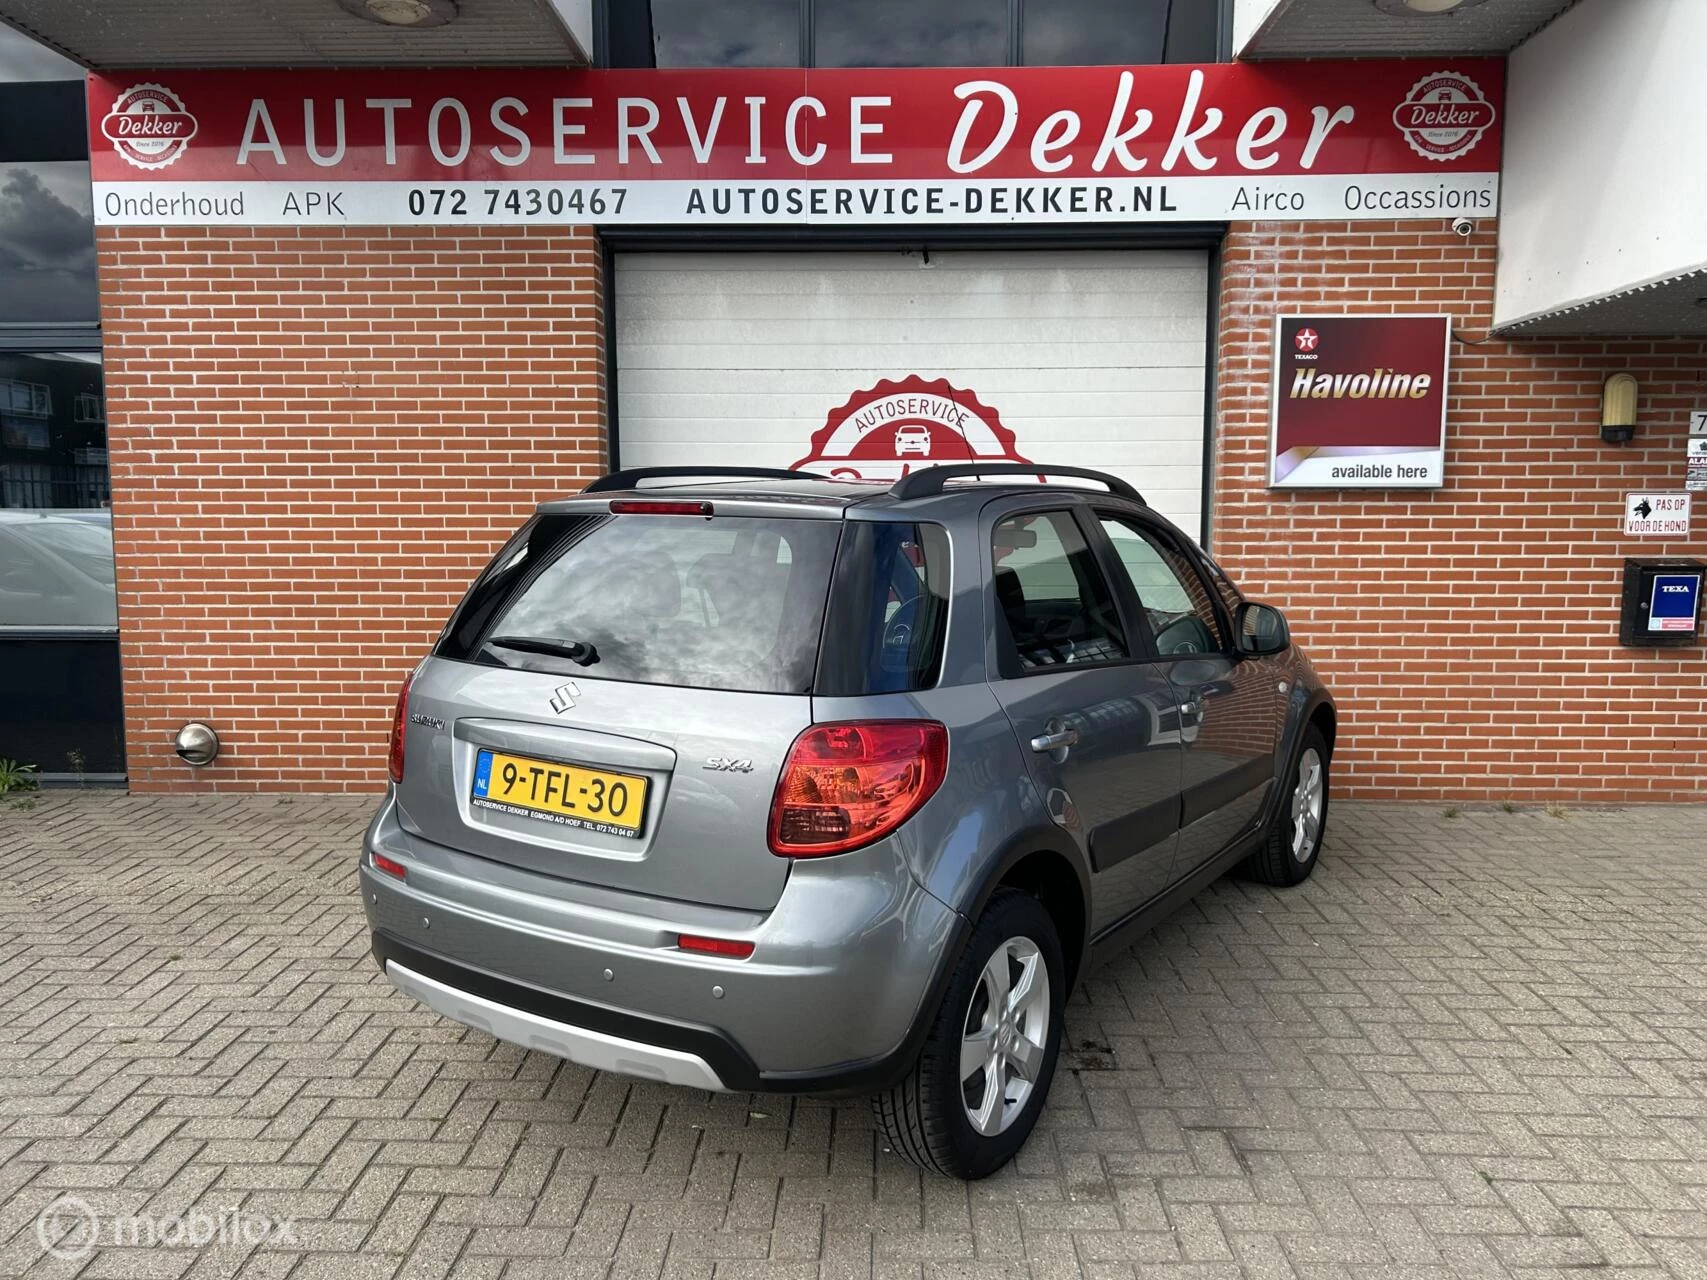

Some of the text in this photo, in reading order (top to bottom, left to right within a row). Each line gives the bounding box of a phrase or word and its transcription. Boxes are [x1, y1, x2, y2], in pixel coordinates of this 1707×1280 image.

[119, 115, 182, 135] Dekker
[236, 69, 1355, 174] AUTOSERVICE Dekker
[1410, 104, 1479, 125] Dekker
[104, 191, 244, 217] Onderhoud
[283, 192, 346, 216] APK
[408, 188, 628, 216] 072 7430467
[686, 185, 1177, 215] AUTOSERVICE-DEKKER.NL
[1232, 186, 1305, 212] Airco
[1344, 184, 1491, 210] Occassions
[1290, 368, 1431, 399] Havoline
[855, 398, 969, 433] AUTOSERVICE
[1331, 464, 1428, 479] available here
[1656, 499, 1685, 510] PAS OP
[1628, 520, 1686, 532] VOOR DE HOND
[1662, 585, 1689, 593] TEXA
[411, 713, 446, 730] SUZUKI
[702, 757, 754, 773] SX4
[477, 778, 487, 790] NL
[502, 762, 628, 817] 9-TFL-30
[472, 799, 507, 812] AUTOSERVICE
[507, 806, 529, 817] DEKKER
[530, 811, 554, 822] EGMOND
[554, 815, 565, 824] A/D
[565, 818, 582, 827] HOEF
[583, 821, 596, 830] TEL.
[596, 824, 607, 833] 072
[608, 826, 618, 835] 743
